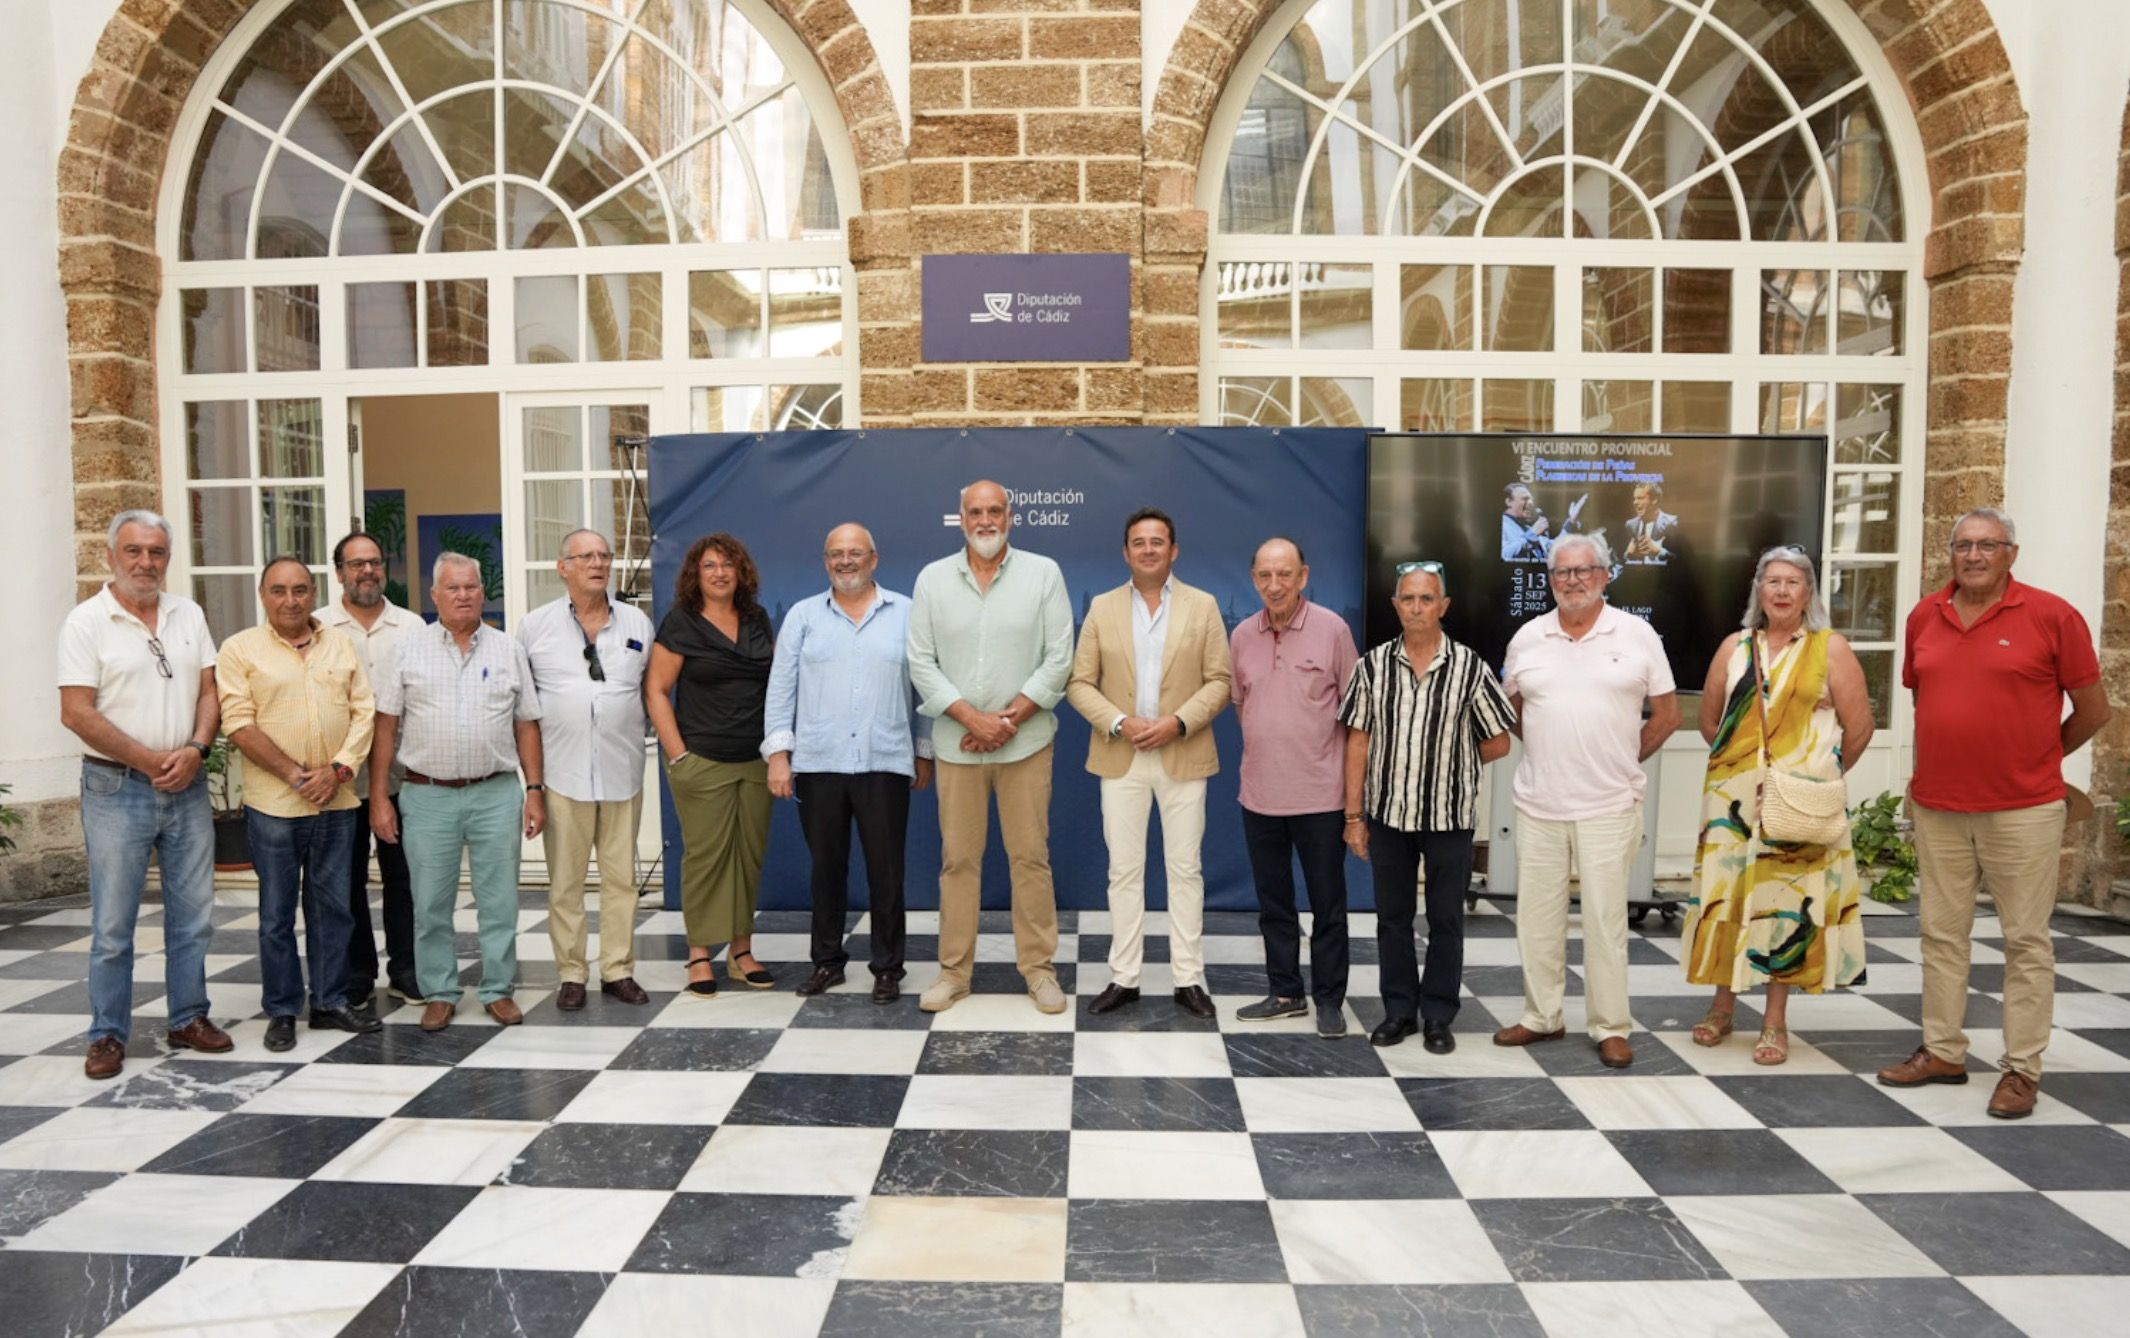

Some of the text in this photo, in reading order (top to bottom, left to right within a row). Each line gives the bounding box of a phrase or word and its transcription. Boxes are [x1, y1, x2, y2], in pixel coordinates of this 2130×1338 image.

[1017, 293, 1082, 307] Diputación
[1017, 309, 1070, 323] de Cádiz
[1512, 442, 1673, 456] VI ENCUENTRO PROVINCIAL
[1027, 509, 1070, 526] Cádiz
[1527, 572, 1547, 589] 13
[1510, 568, 1524, 617] Sábado
[1525, 590, 1547, 600] SEP
[1523, 601, 1547, 611] 2025
